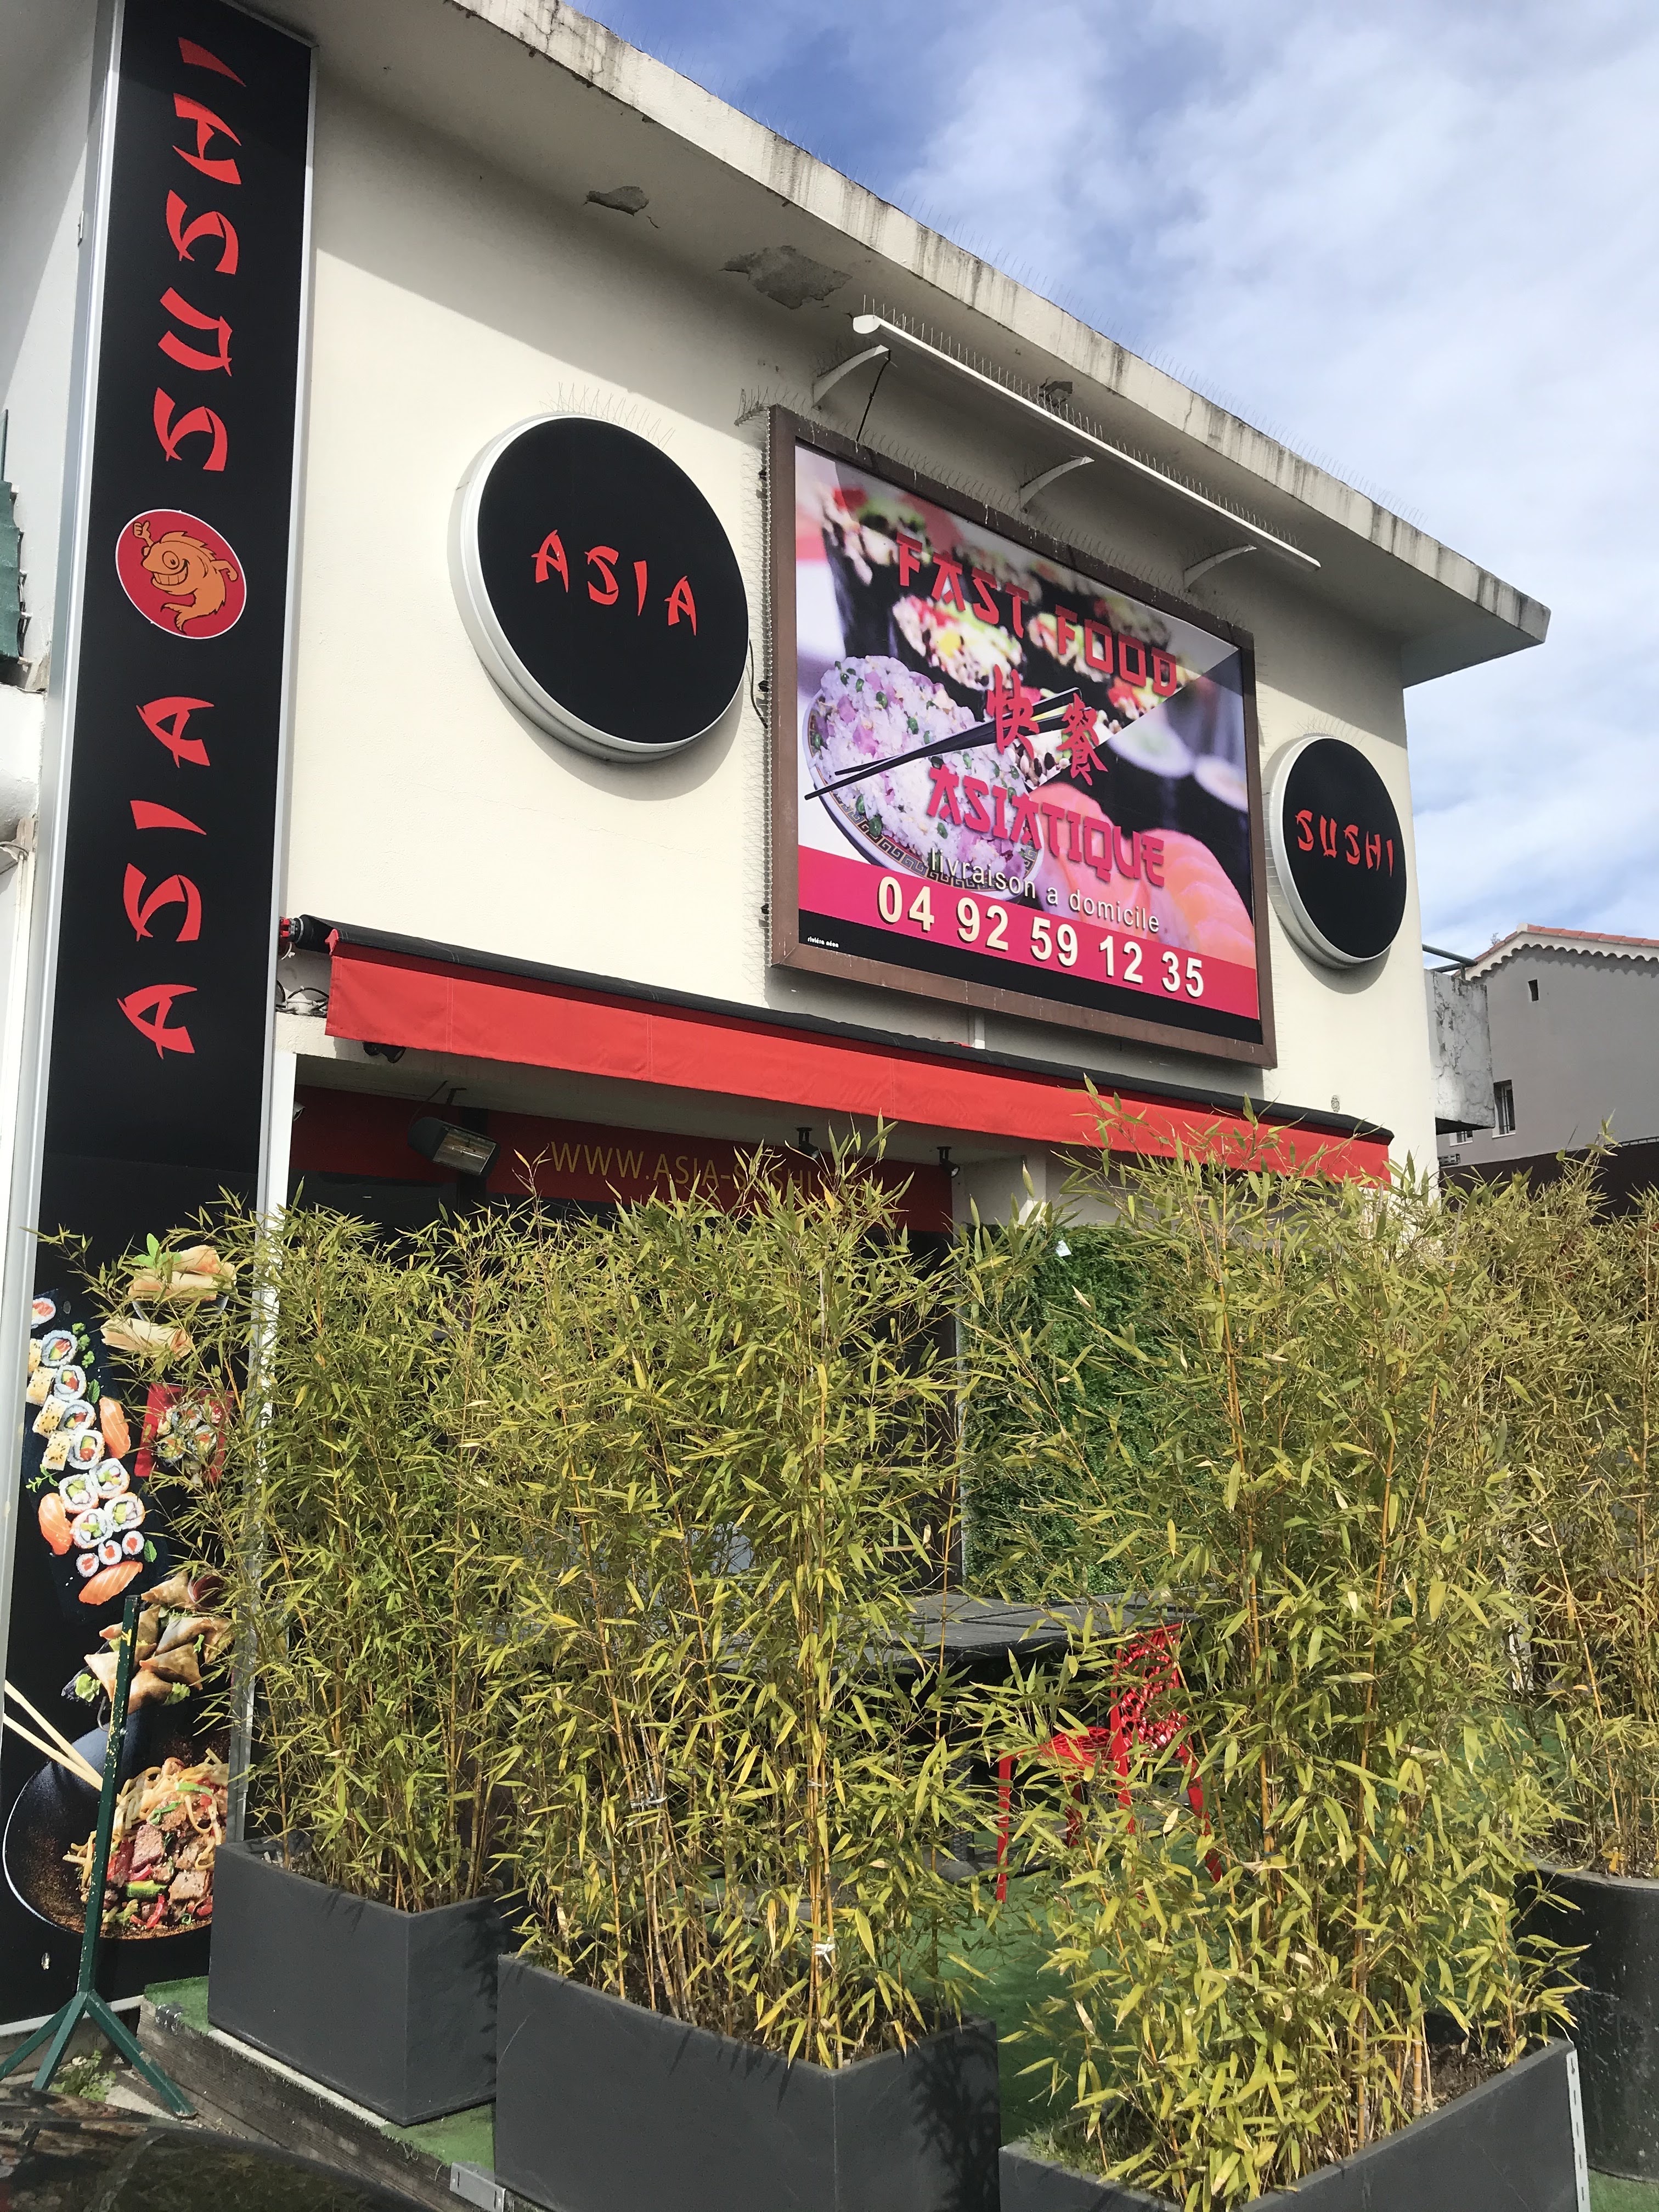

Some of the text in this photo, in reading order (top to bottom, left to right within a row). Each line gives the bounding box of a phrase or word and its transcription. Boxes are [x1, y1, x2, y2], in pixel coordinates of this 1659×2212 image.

[117, 36, 246, 1059] ASIA SUSHI
[531, 529, 697, 636] ASIA
[895, 532, 1177, 697] FAST FOOD
[986, 664, 1109, 786] 快餐
[928, 765, 1165, 887] ASIATIQUE
[1295, 810, 1393, 877] SUSHI
[878, 876, 1204, 998] 04 92 59 12 35
[930, 847, 1160, 933] livraison a domicile
